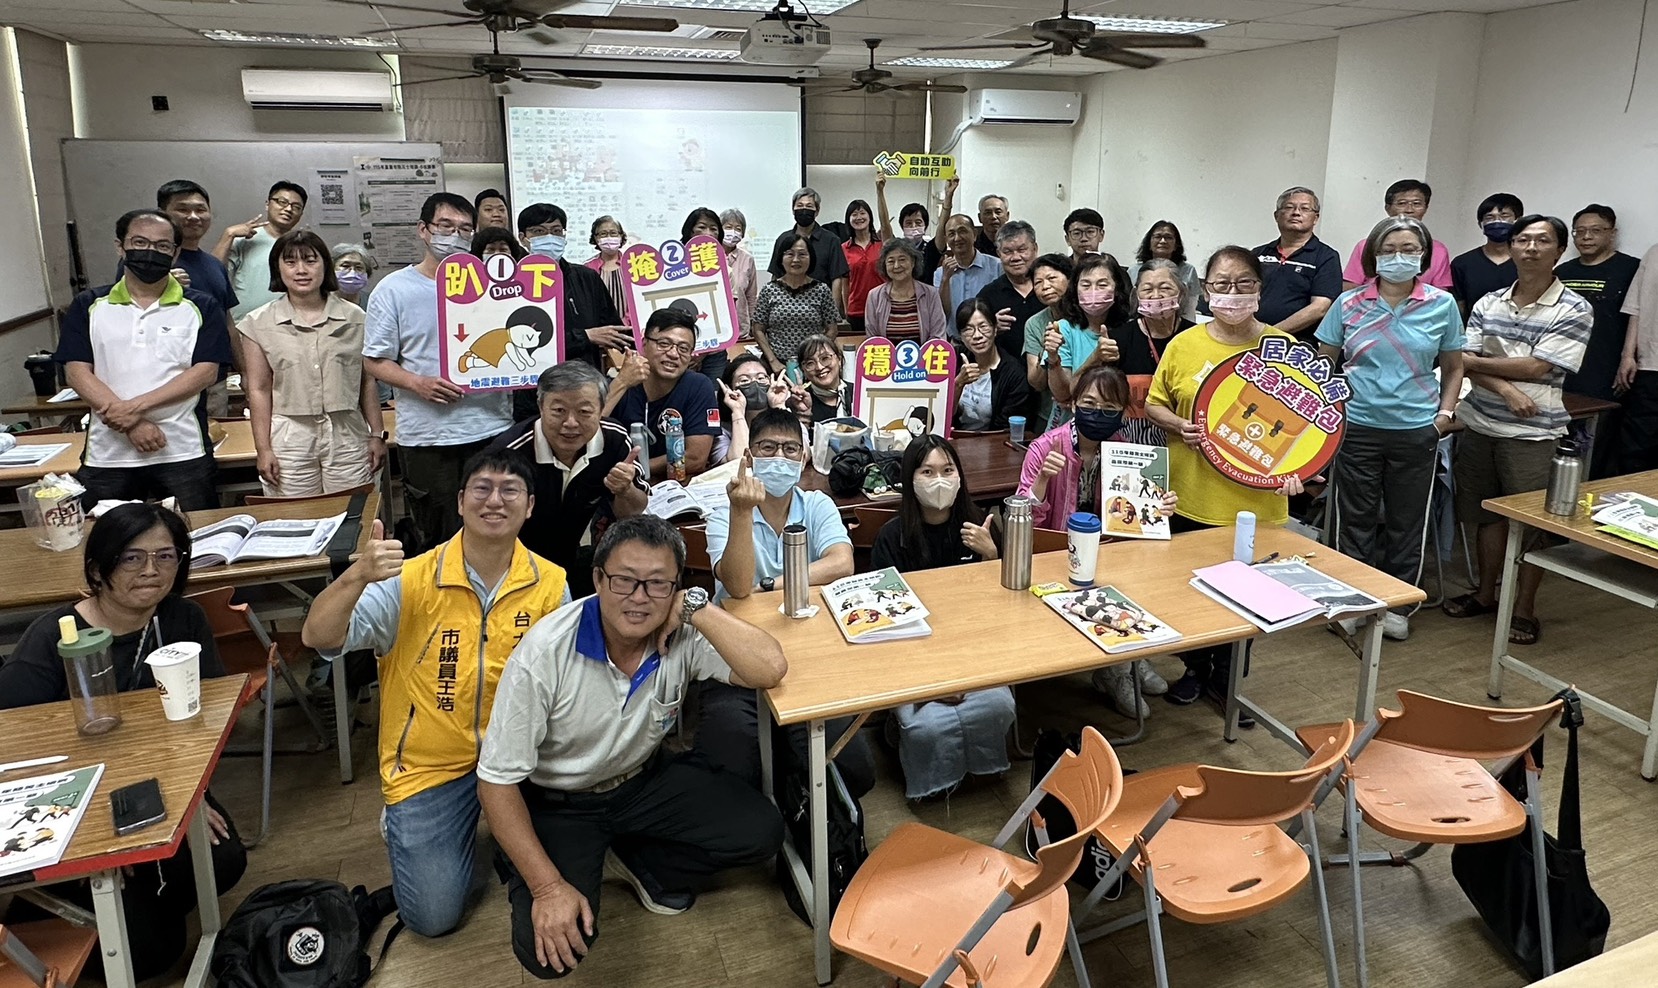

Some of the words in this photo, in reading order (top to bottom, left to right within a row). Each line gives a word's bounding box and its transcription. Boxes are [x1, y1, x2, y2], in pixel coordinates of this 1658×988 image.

[909, 156, 951, 167] 自助互助
[909, 167, 940, 177] 向前行
[627, 251, 660, 283] 掩
[668, 246, 681, 262] 2
[688, 242, 720, 273] 護
[665, 266, 689, 279] Cover
[445, 262, 484, 297] 趴
[521, 263, 555, 298] 下
[492, 284, 522, 298] Drop
[863, 345, 891, 376] 穩
[903, 347, 914, 364] 3
[922, 344, 950, 375] 住
[894, 371, 914, 380] Hold
[915, 371, 926, 379] on
[1262, 339, 1350, 402] 居家必備
[1236, 352, 1343, 434] 緊急避難包
[1197, 418, 1222, 465] Emergency
[1222, 462, 1274, 485] Evacuation
[437, 629, 460, 712] 市議員王浩
